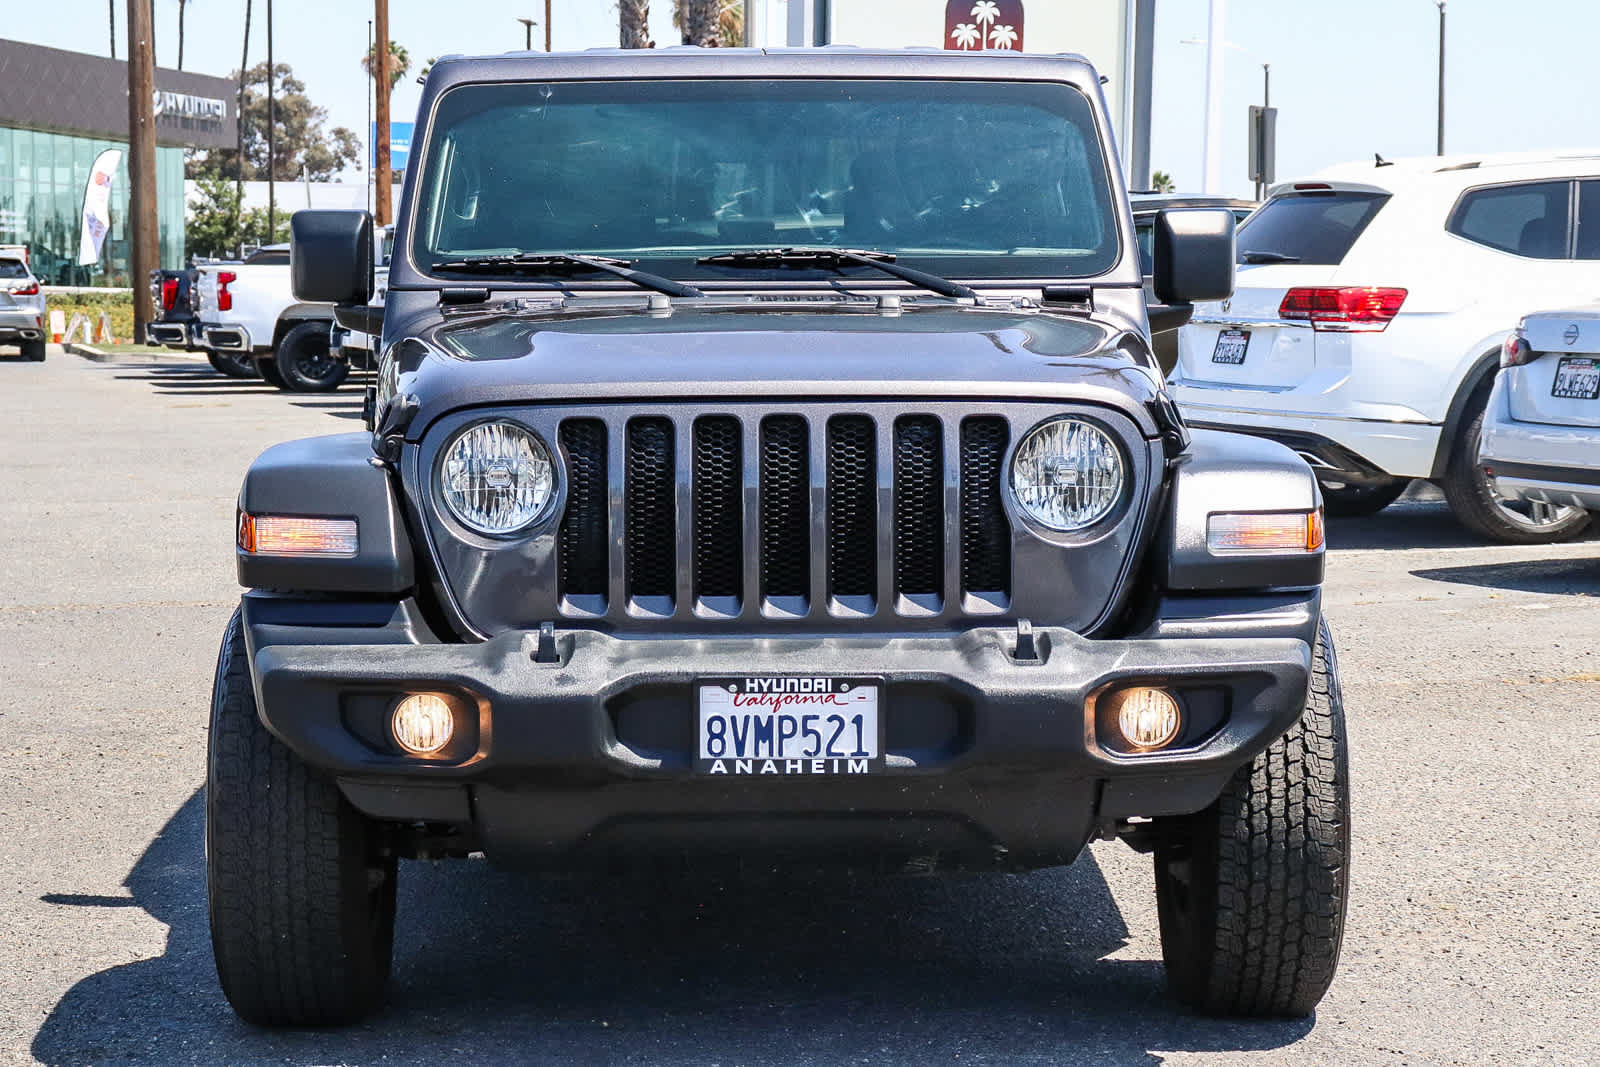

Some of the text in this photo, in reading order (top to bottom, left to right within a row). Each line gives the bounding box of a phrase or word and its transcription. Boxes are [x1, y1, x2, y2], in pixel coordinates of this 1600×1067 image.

[745, 678, 833, 693] HYUNDAI
[733, 692, 849, 713] California
[706, 714, 870, 758] 8VMP521
[709, 759, 869, 774] ANAHEIM
